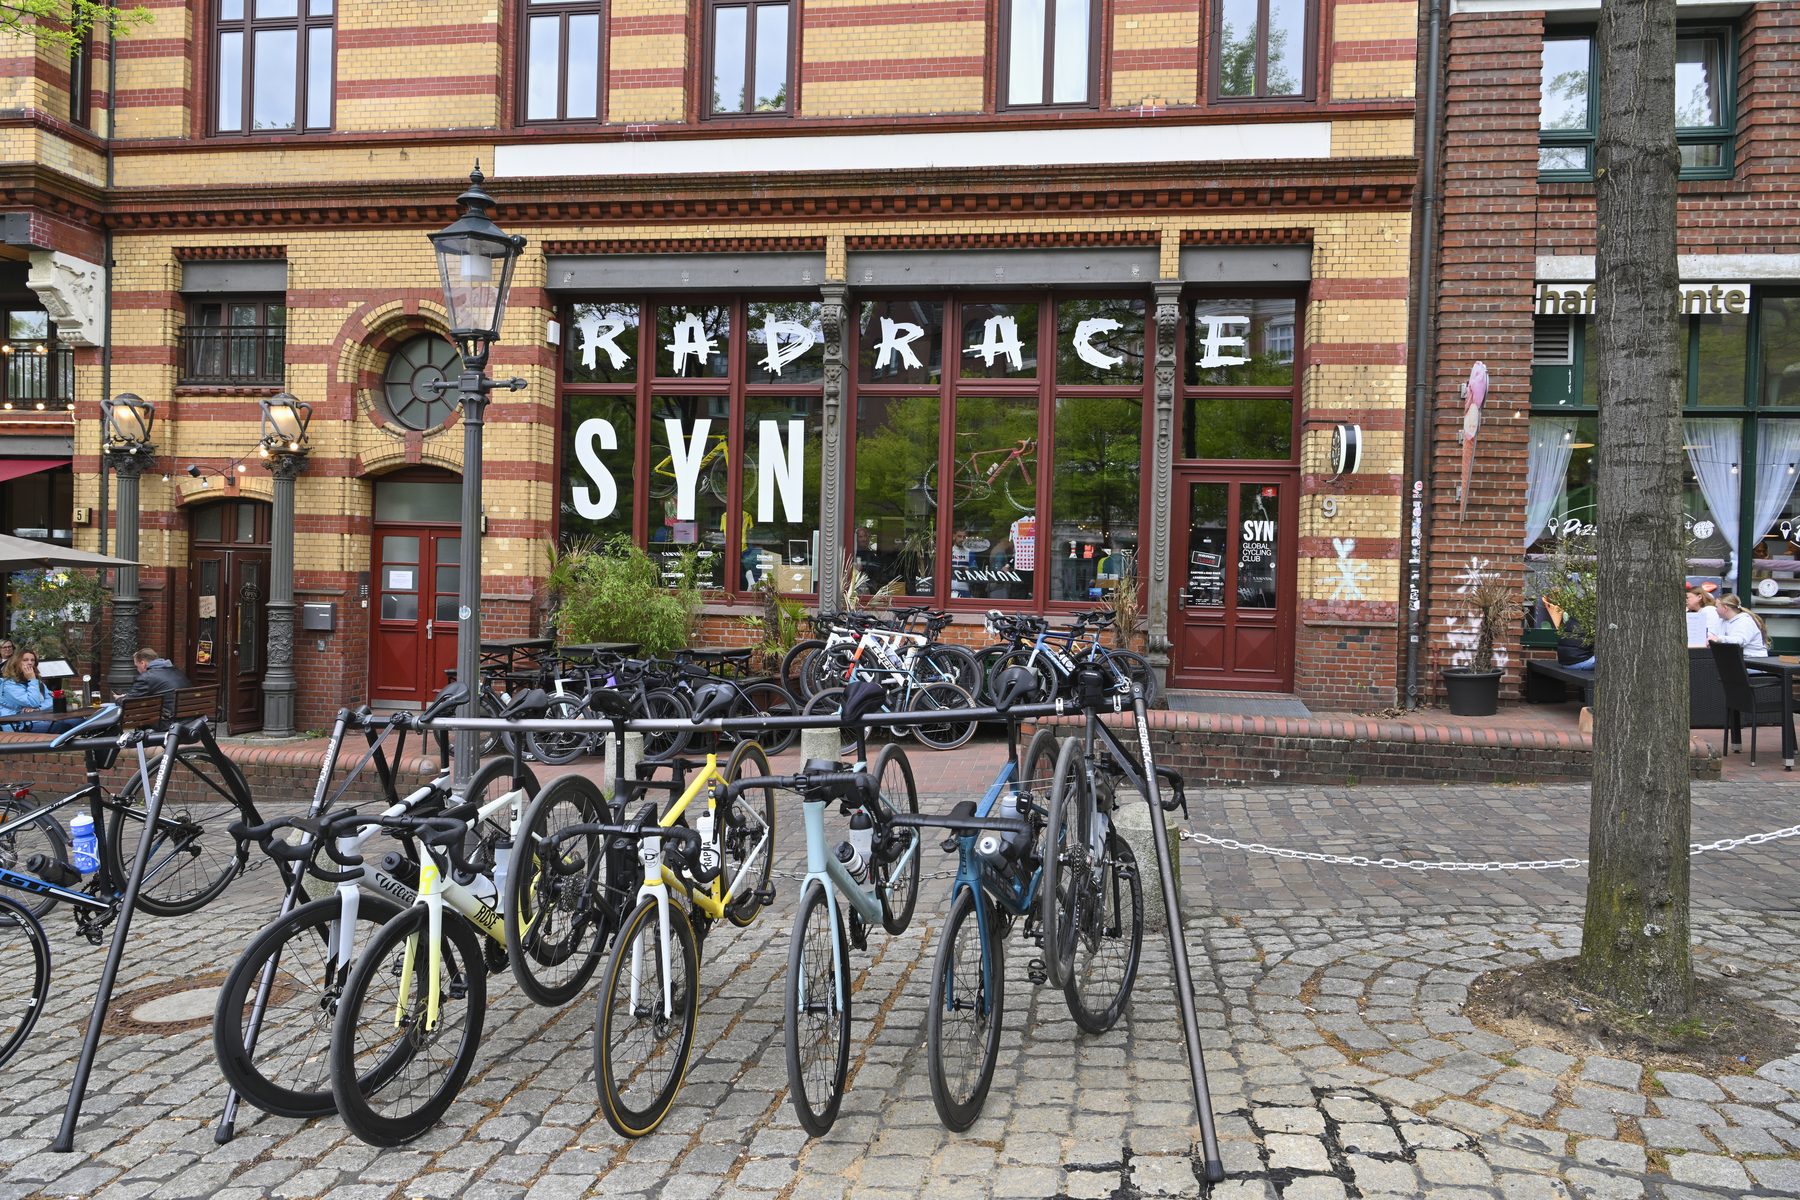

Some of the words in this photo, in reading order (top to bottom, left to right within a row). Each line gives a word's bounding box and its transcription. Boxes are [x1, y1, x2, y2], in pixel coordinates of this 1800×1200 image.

[577, 313, 816, 377] RAD
[873, 314, 1252, 371] RACE
[571, 417, 806, 524] SYN
[76, 509, 83, 521] 5
[1323, 497, 1337, 517] 9
[1243, 520, 1274, 542] SYN
[1242, 542, 1270, 550] GLOBAL
[954, 569, 1022, 582] CANYON
[1137, 716, 1152, 763] FEEDBACK
[319, 738, 336, 783] FEEDBACK
[152, 754, 169, 797] FEEDBACK
[474, 905, 500, 930] ROSE
